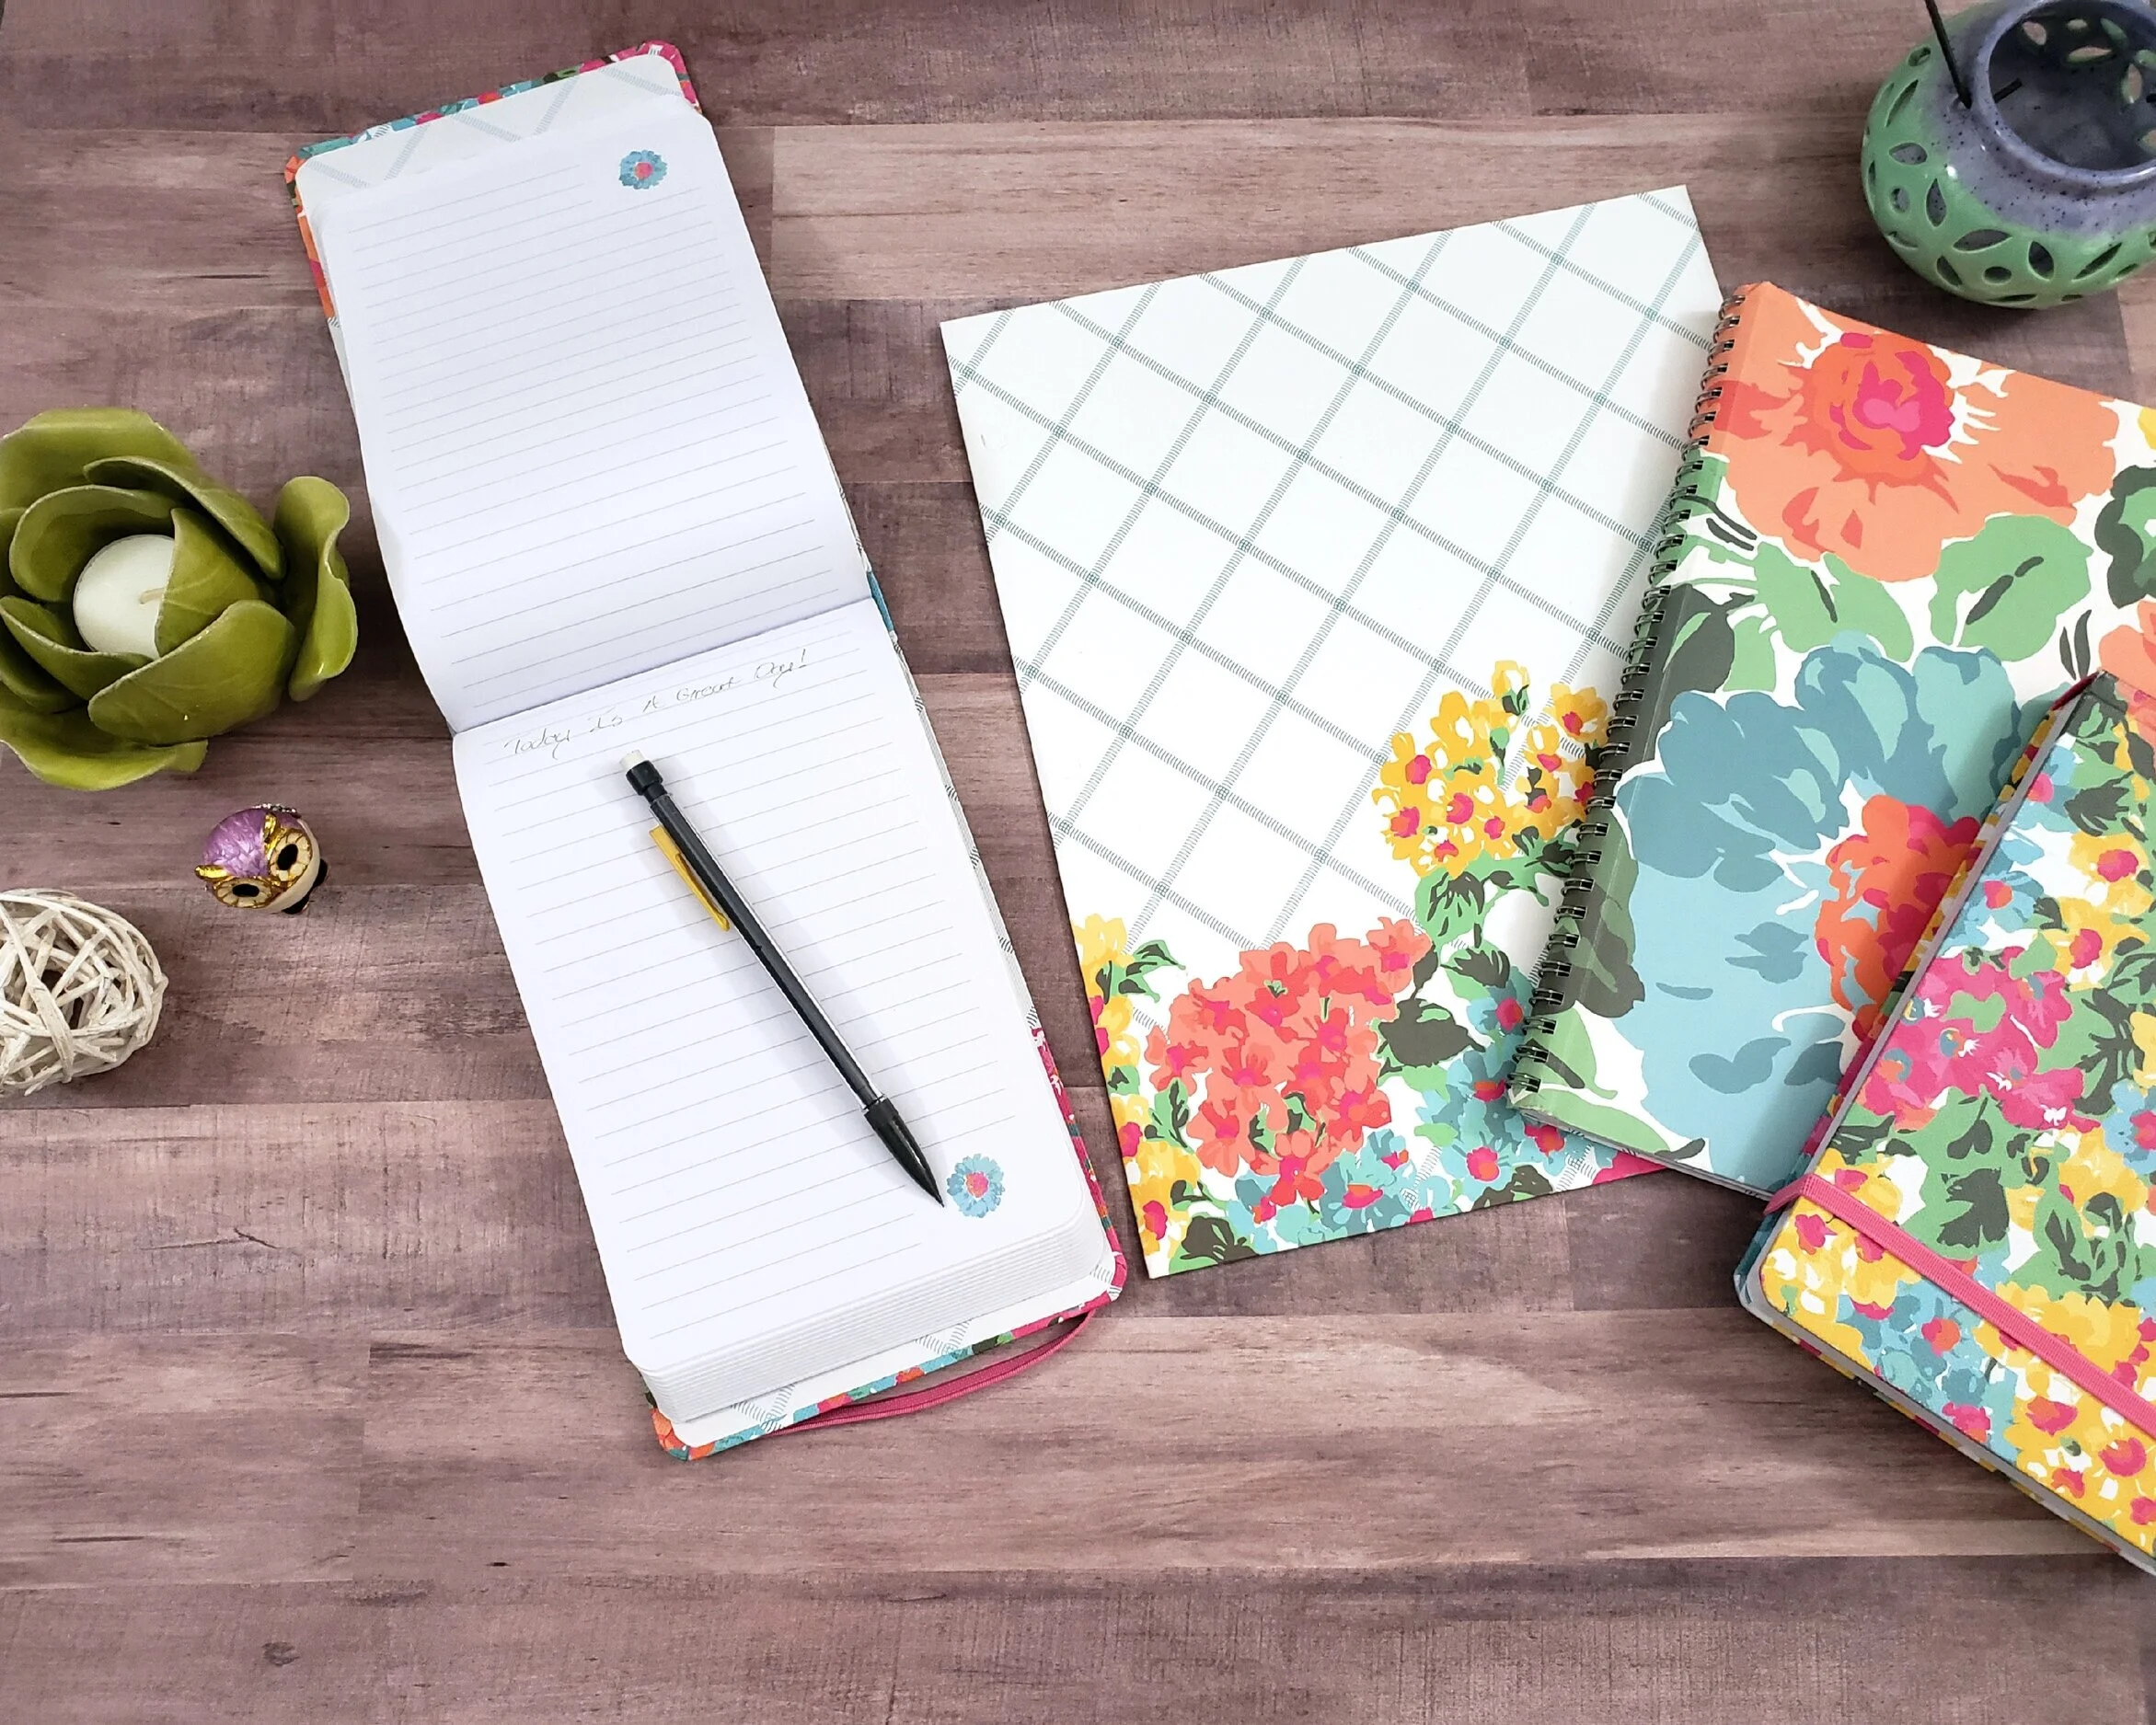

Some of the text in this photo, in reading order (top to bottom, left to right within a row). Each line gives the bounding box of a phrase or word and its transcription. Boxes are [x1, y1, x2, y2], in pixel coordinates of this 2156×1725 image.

[504, 728, 571, 760] Today
[642, 696, 662, 712] A
[676, 676, 742, 702] Great
